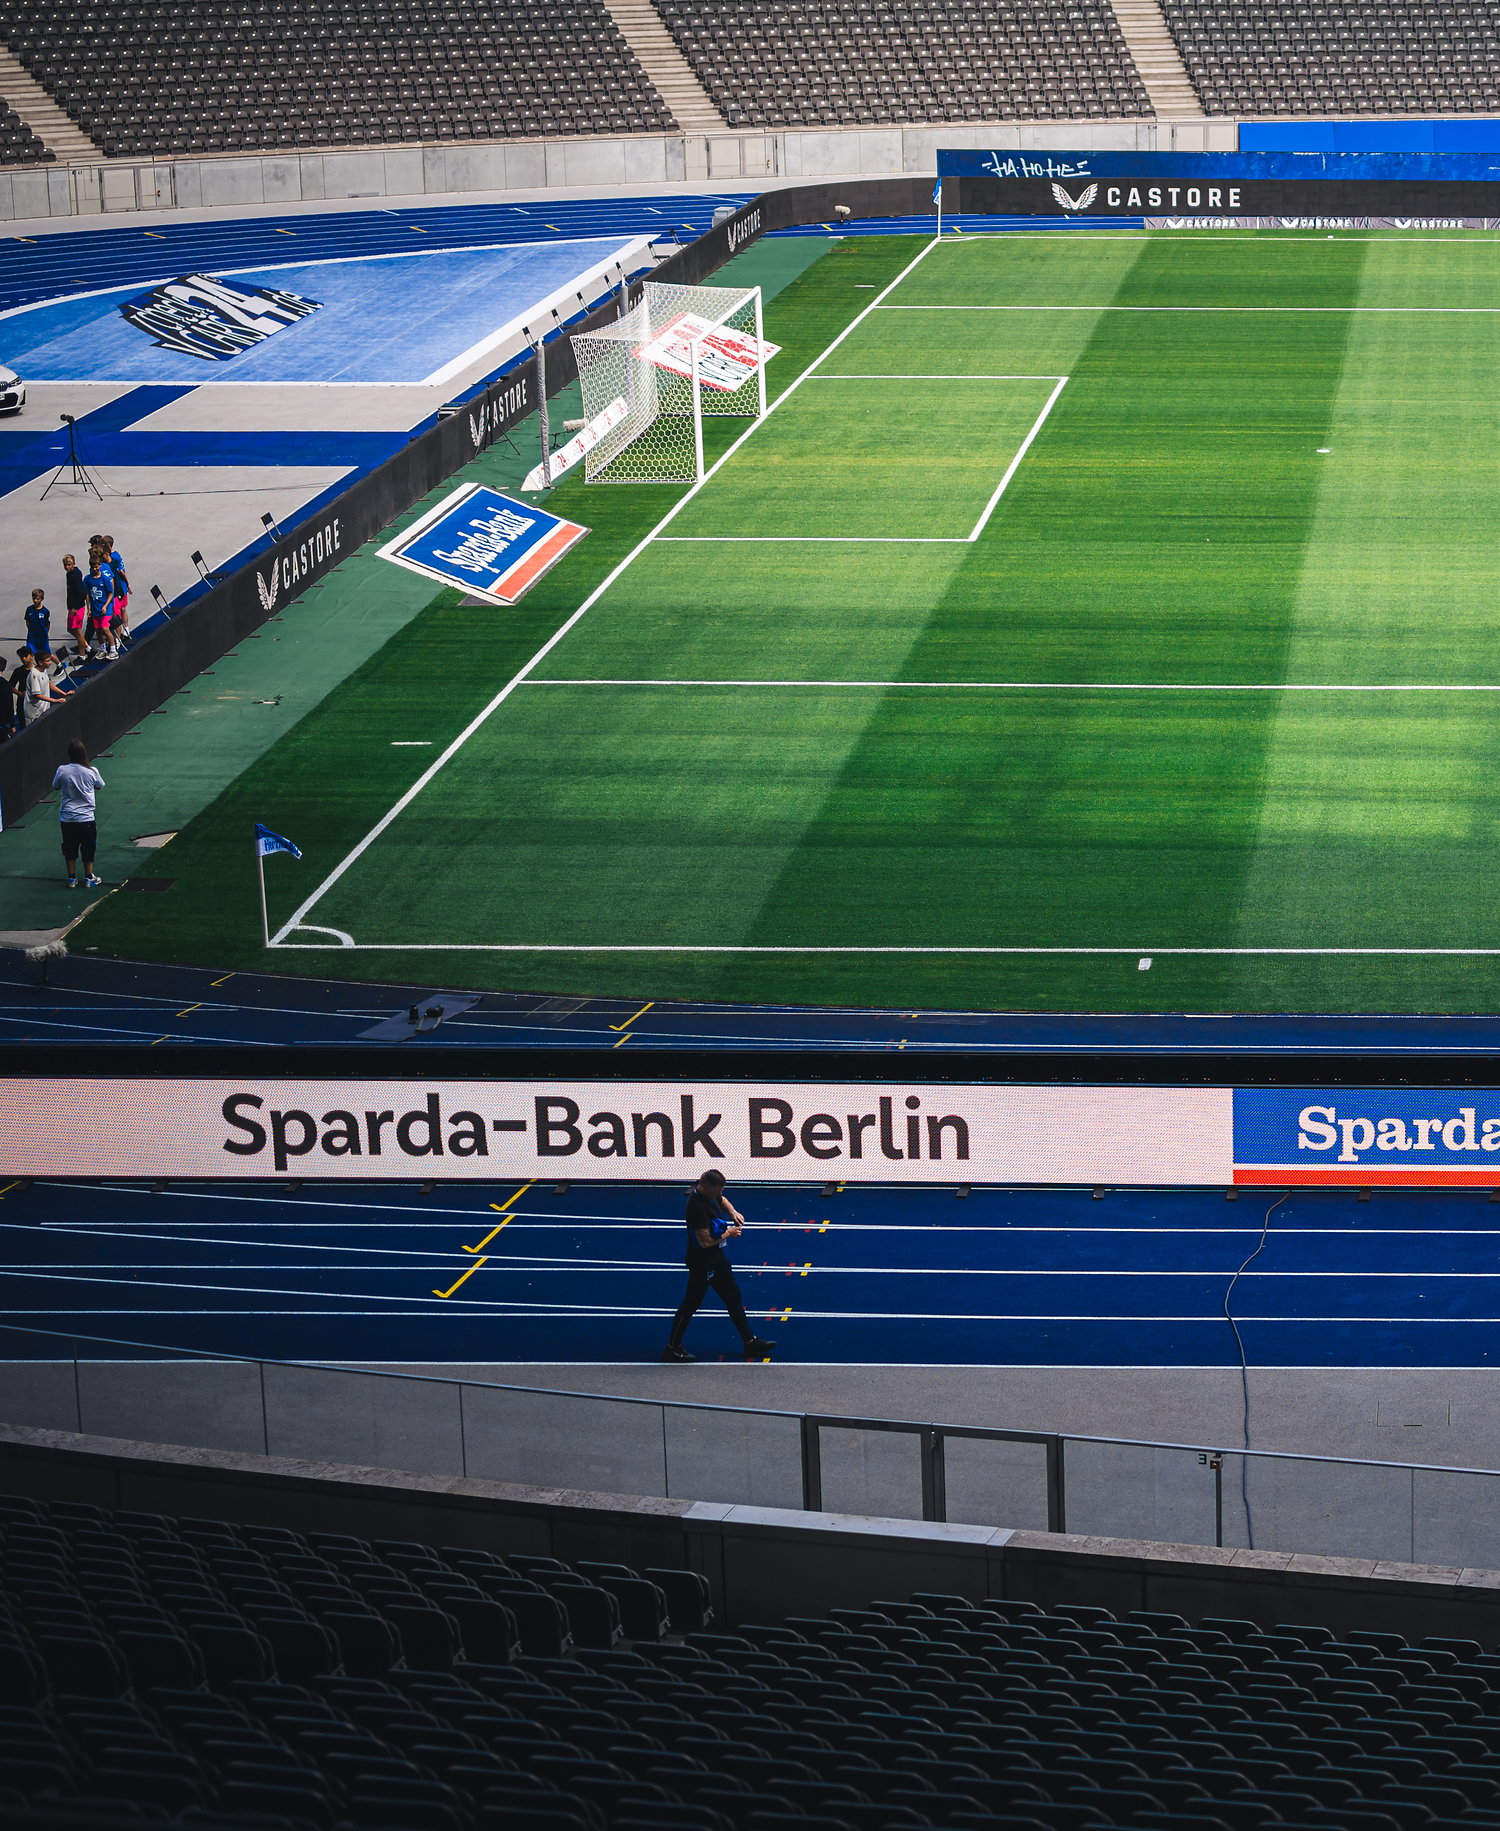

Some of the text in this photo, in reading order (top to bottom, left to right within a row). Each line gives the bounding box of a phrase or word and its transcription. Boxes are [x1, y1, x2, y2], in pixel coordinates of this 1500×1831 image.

[1107, 187, 1241, 208] CASTORE
[282, 518, 340, 590] CASTORE
[221, 1092, 971, 1172] Sparda-Bank Berlin
